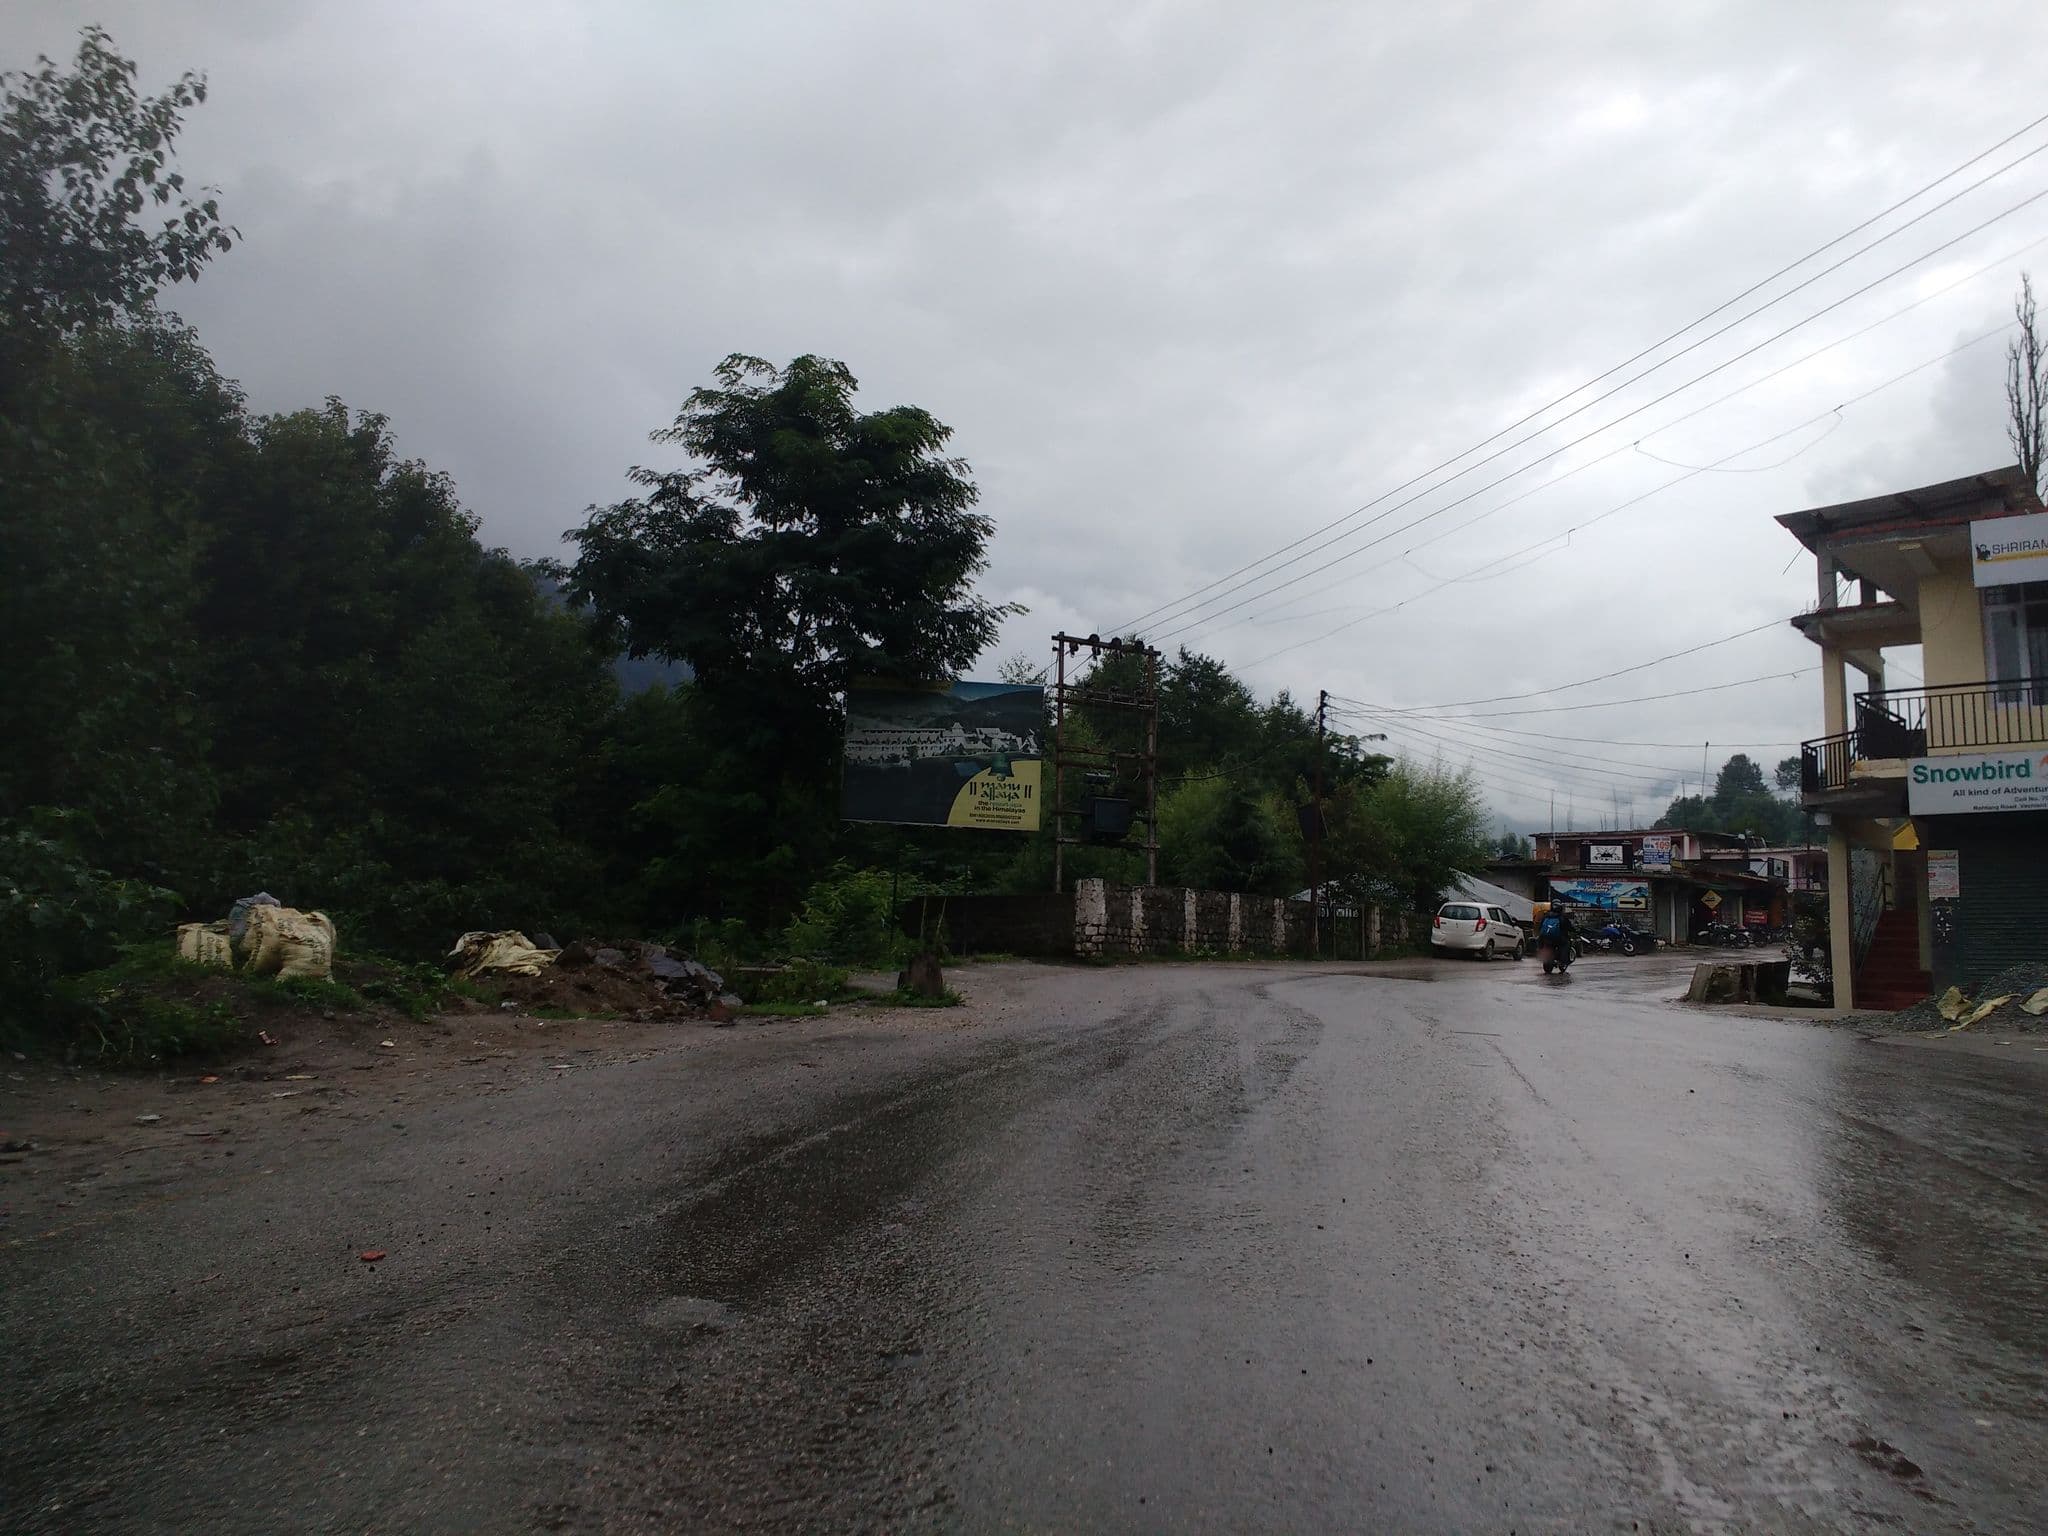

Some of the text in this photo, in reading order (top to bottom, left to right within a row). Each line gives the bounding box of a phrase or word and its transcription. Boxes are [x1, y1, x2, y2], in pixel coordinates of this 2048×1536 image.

[1912, 758, 2031, 785] Snowbird
[1952, 789, 1966, 798] All
[1968, 786, 1989, 797] kind
[1991, 786, 2003, 796] of
